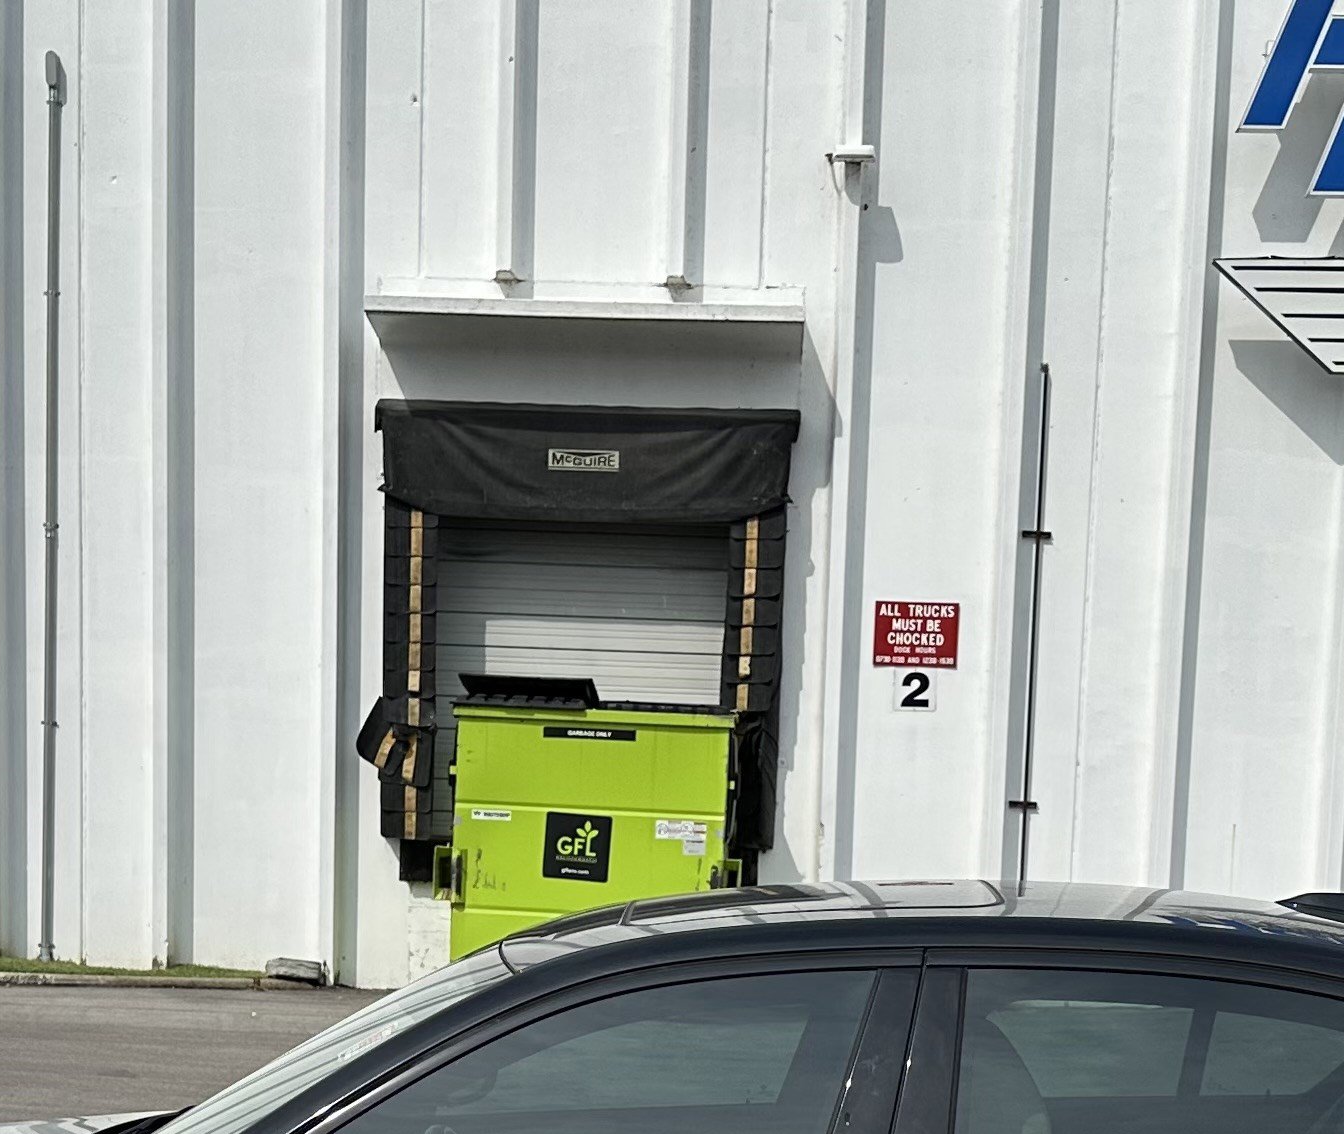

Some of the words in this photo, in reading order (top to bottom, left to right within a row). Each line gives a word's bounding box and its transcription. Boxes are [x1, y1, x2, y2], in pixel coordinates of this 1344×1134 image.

[552, 452, 615, 467] McGUIRE
[879, 603, 901, 617] ALL
[908, 604, 955, 617] TRUCKS
[891, 618, 923, 632] MUST
[926, 619, 942, 632] BE
[887, 632, 945, 646] CHOCKED
[901, 672, 930, 708] 2
[557, 834, 598, 857] GFL
